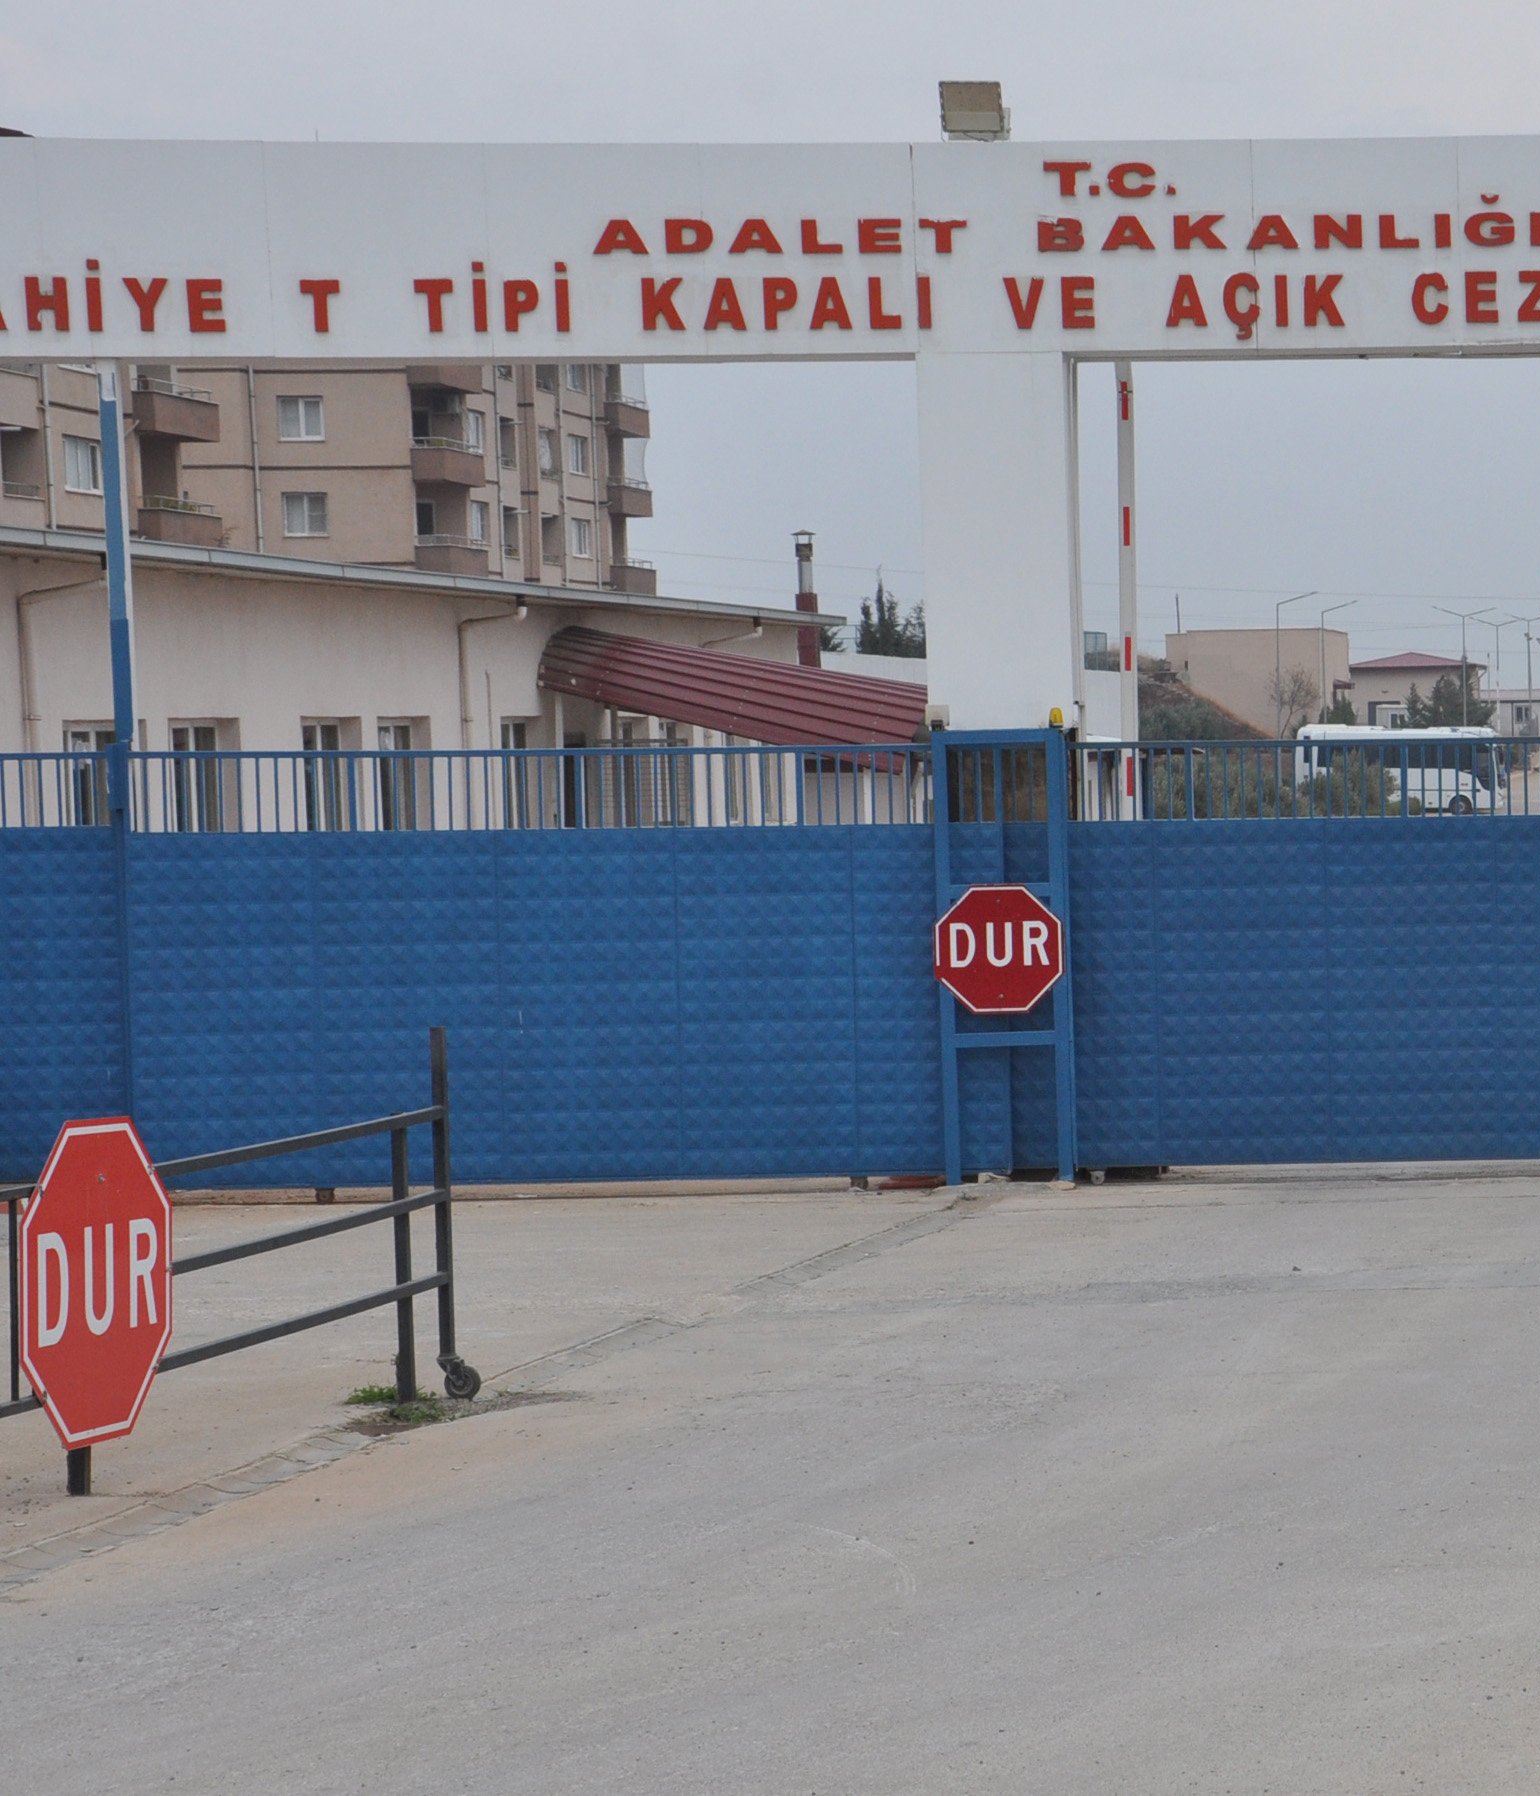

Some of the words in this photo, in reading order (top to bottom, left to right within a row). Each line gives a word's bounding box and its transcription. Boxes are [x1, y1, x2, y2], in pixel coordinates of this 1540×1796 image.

[1044, 161, 1177, 197] T.C.
[594, 217, 968, 254] ADALET
[300, 279, 340, 332] T
[414, 260, 571, 332] TİPİ
[642, 275, 932, 331] KAPALI
[1002, 275, 1096, 330] VE
[1165, 271, 1345, 339] AÇIK
[949, 919, 1051, 969] DUR
[36, 1216, 158, 1349] DUR
